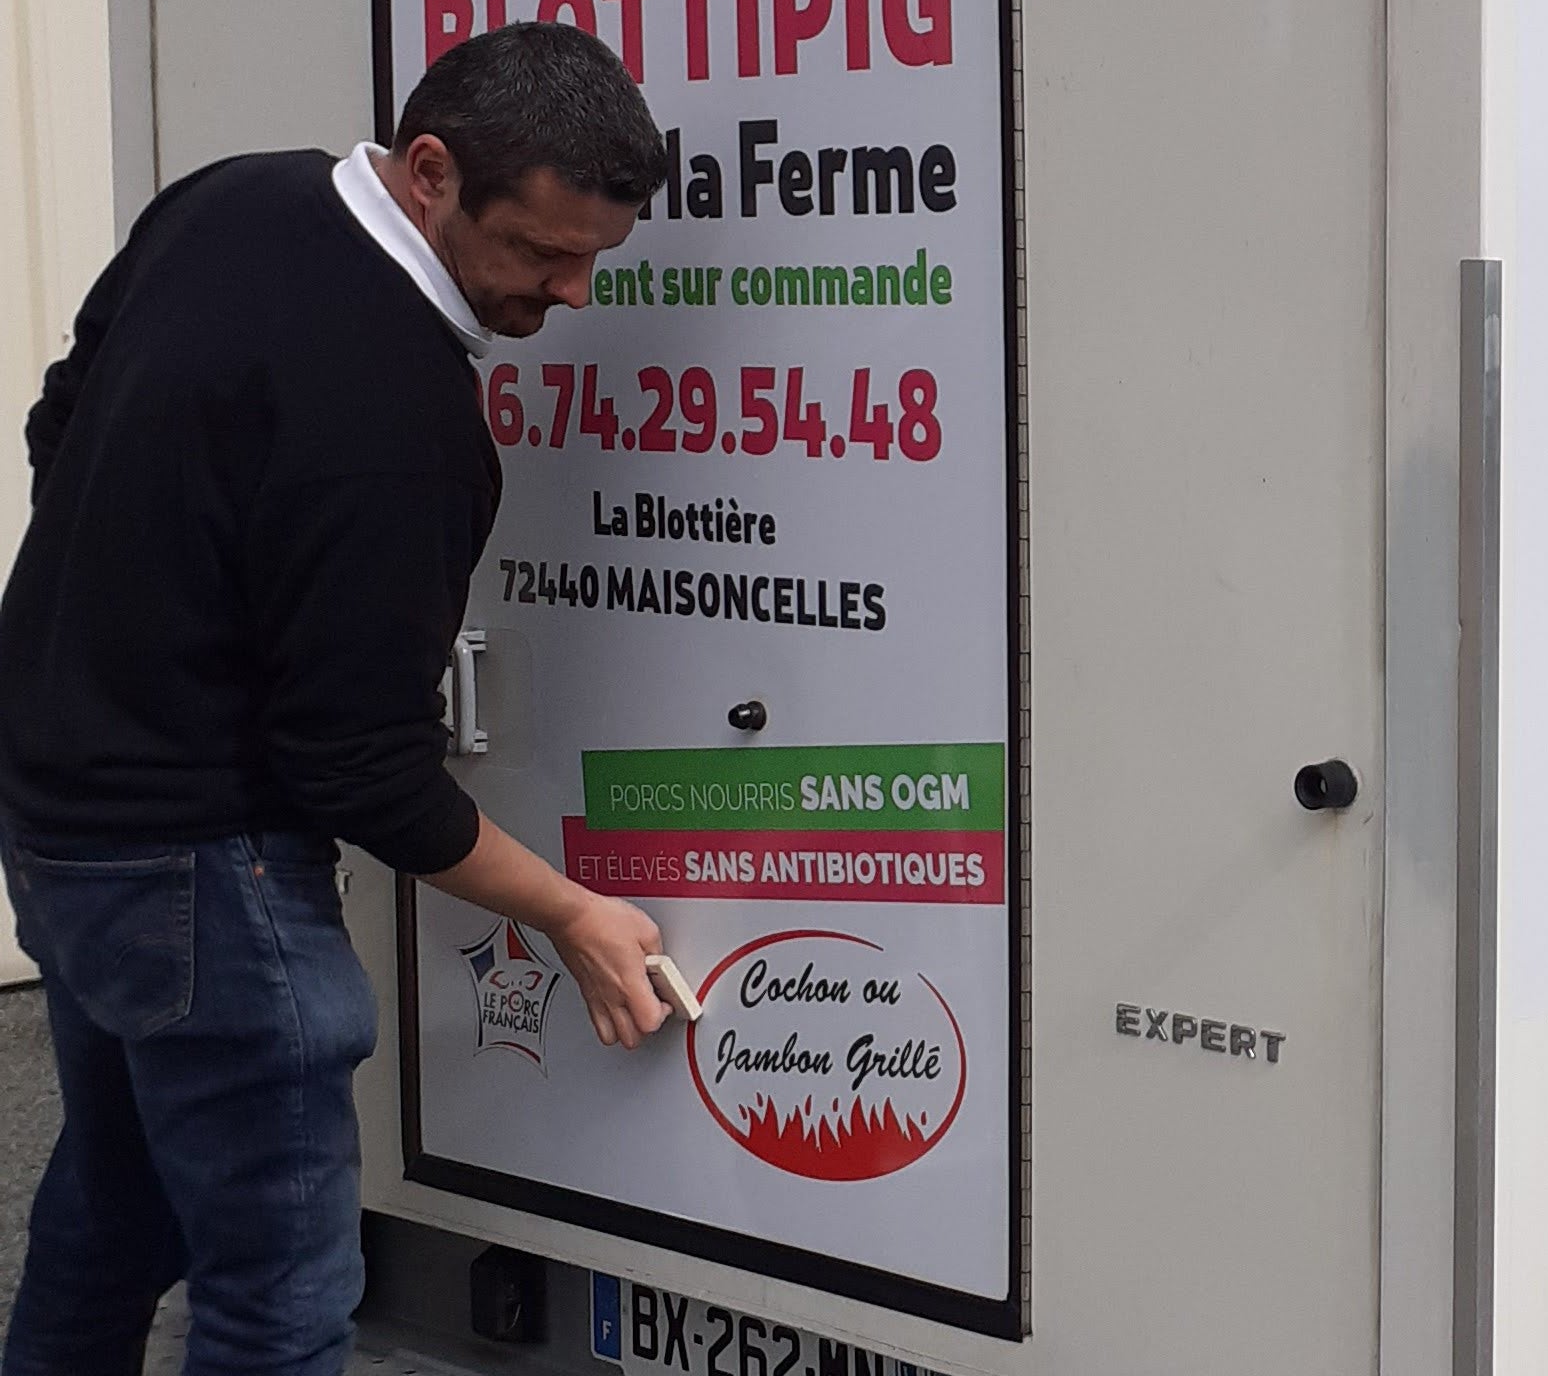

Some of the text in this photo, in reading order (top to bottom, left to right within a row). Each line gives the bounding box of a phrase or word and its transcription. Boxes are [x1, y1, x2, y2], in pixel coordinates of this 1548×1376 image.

[665, 119, 957, 220] la Ferme
[662, 266, 723, 306] sur
[731, 248, 953, 306] commande
[474, 362, 943, 462] 6.74.29.54.48
[593, 490, 776, 545] La Blottière
[500, 559, 887, 632] 72440 MAISONCELLES
[610, 773, 970, 811] PORCS NOURRIS SANS OGM
[579, 850, 985, 886] ET ÉLEVÉS SANS ANTIBIOTIQUES
[484, 990, 540, 1018] LE PORC
[740, 959, 901, 1009] Cochon ou
[482, 1009, 540, 1035] FRANÇAIS
[1115, 1002, 1287, 1064] EXPERT
[715, 1029, 941, 1092] Jambon Grillé
[602, 1319, 612, 1341] F
